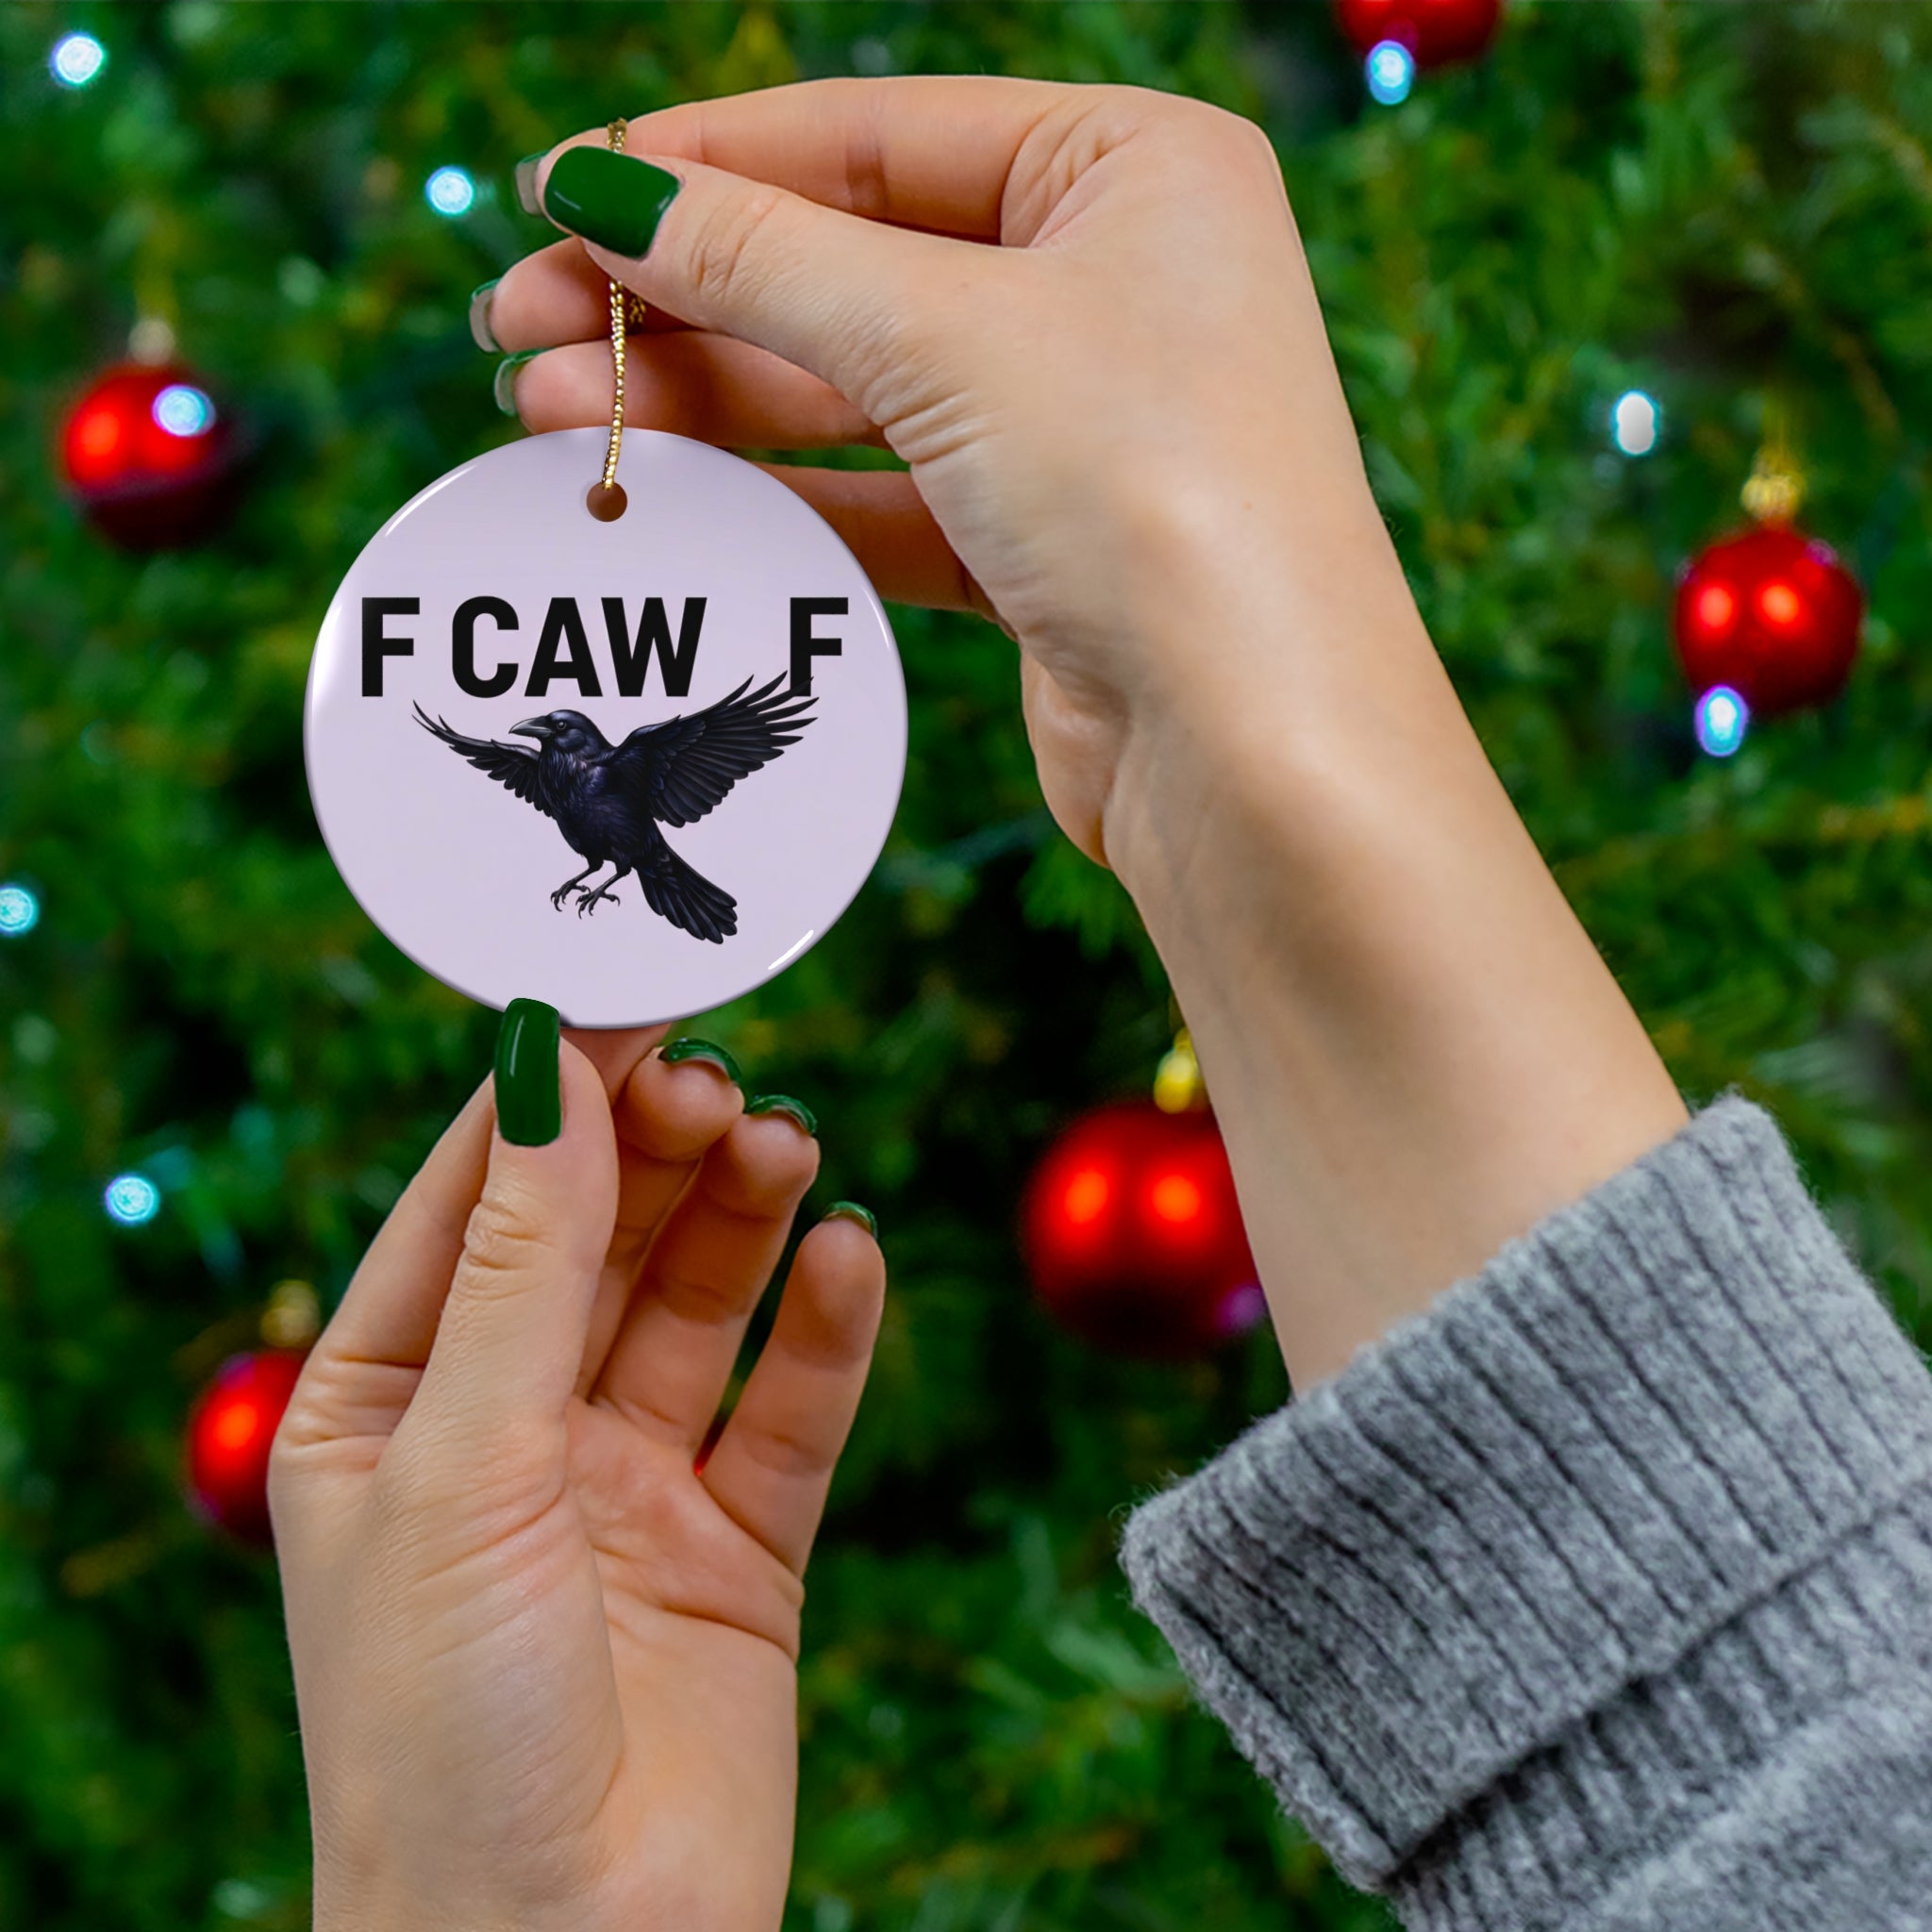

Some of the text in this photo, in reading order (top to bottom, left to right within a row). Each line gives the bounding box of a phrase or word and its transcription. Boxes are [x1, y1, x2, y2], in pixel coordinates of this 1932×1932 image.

[362, 596, 849, 698] F CAW F
